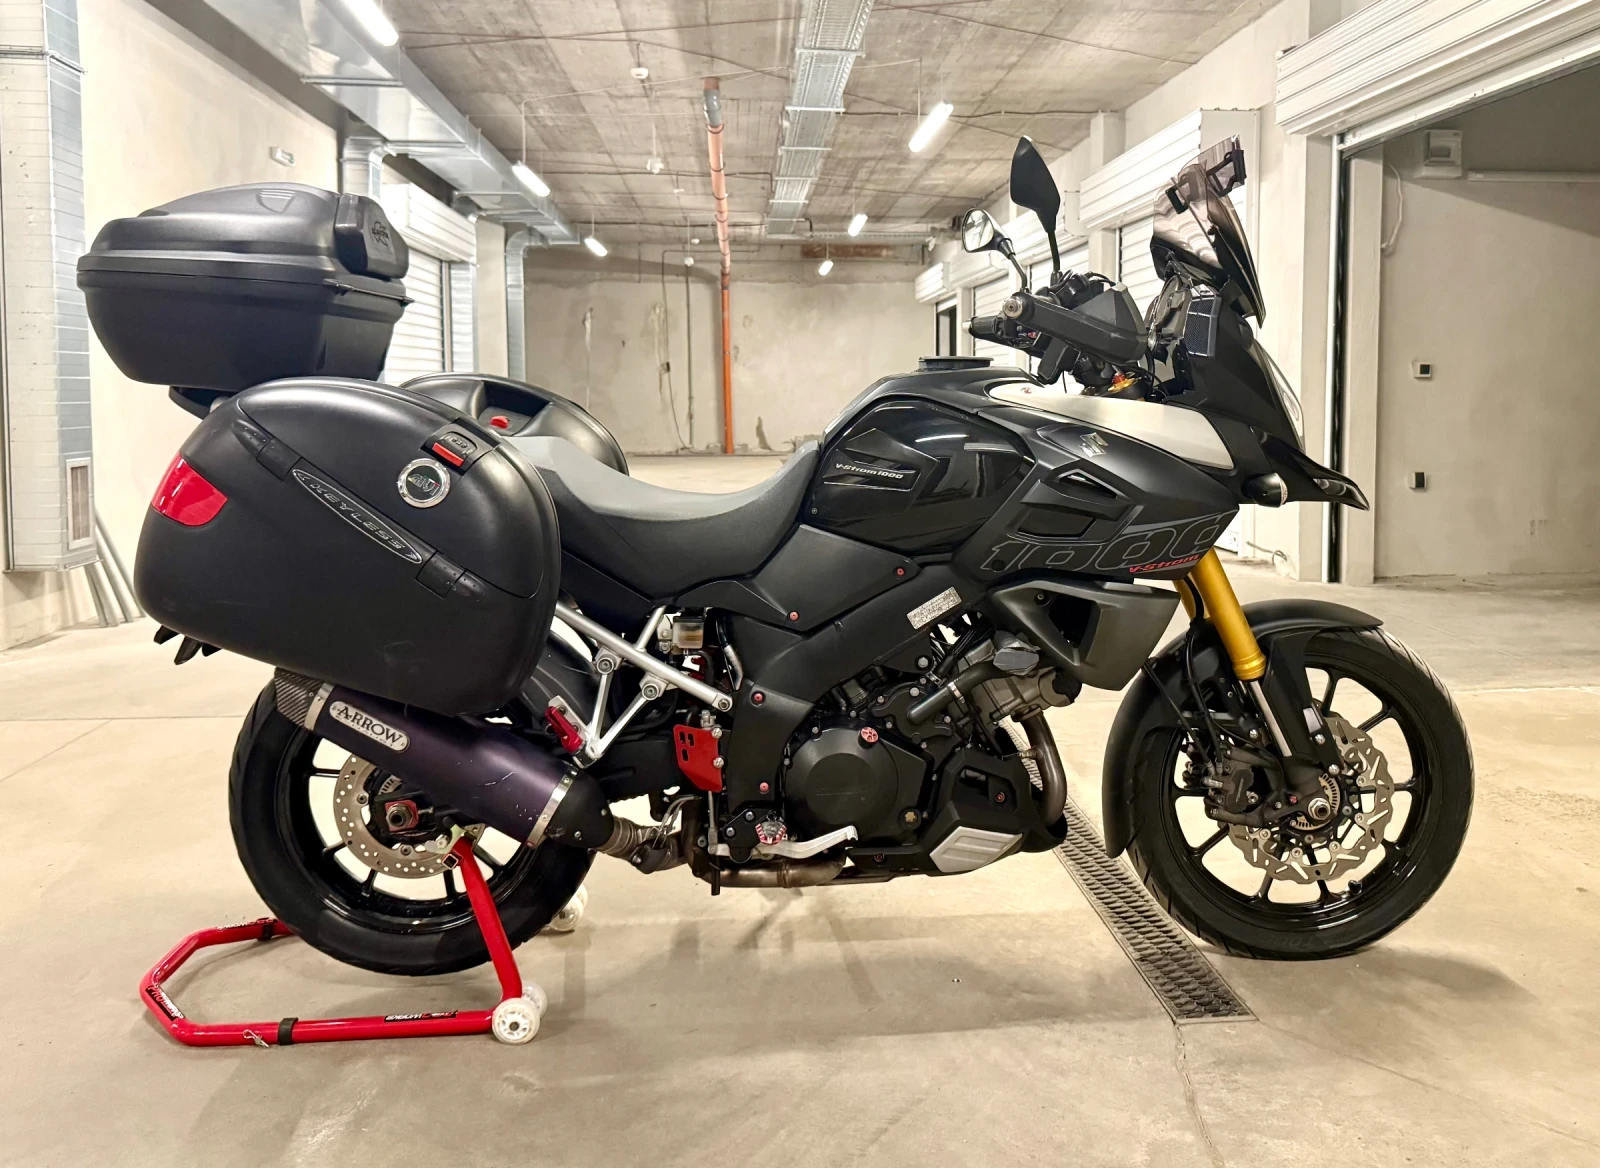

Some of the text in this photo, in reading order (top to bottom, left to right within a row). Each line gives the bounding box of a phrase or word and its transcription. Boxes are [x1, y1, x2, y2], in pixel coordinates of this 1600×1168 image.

[310, 483, 406, 549] KEYLESS
[1129, 554, 1200, 573] V-Strom
[337, 705, 403, 744] ARROW
